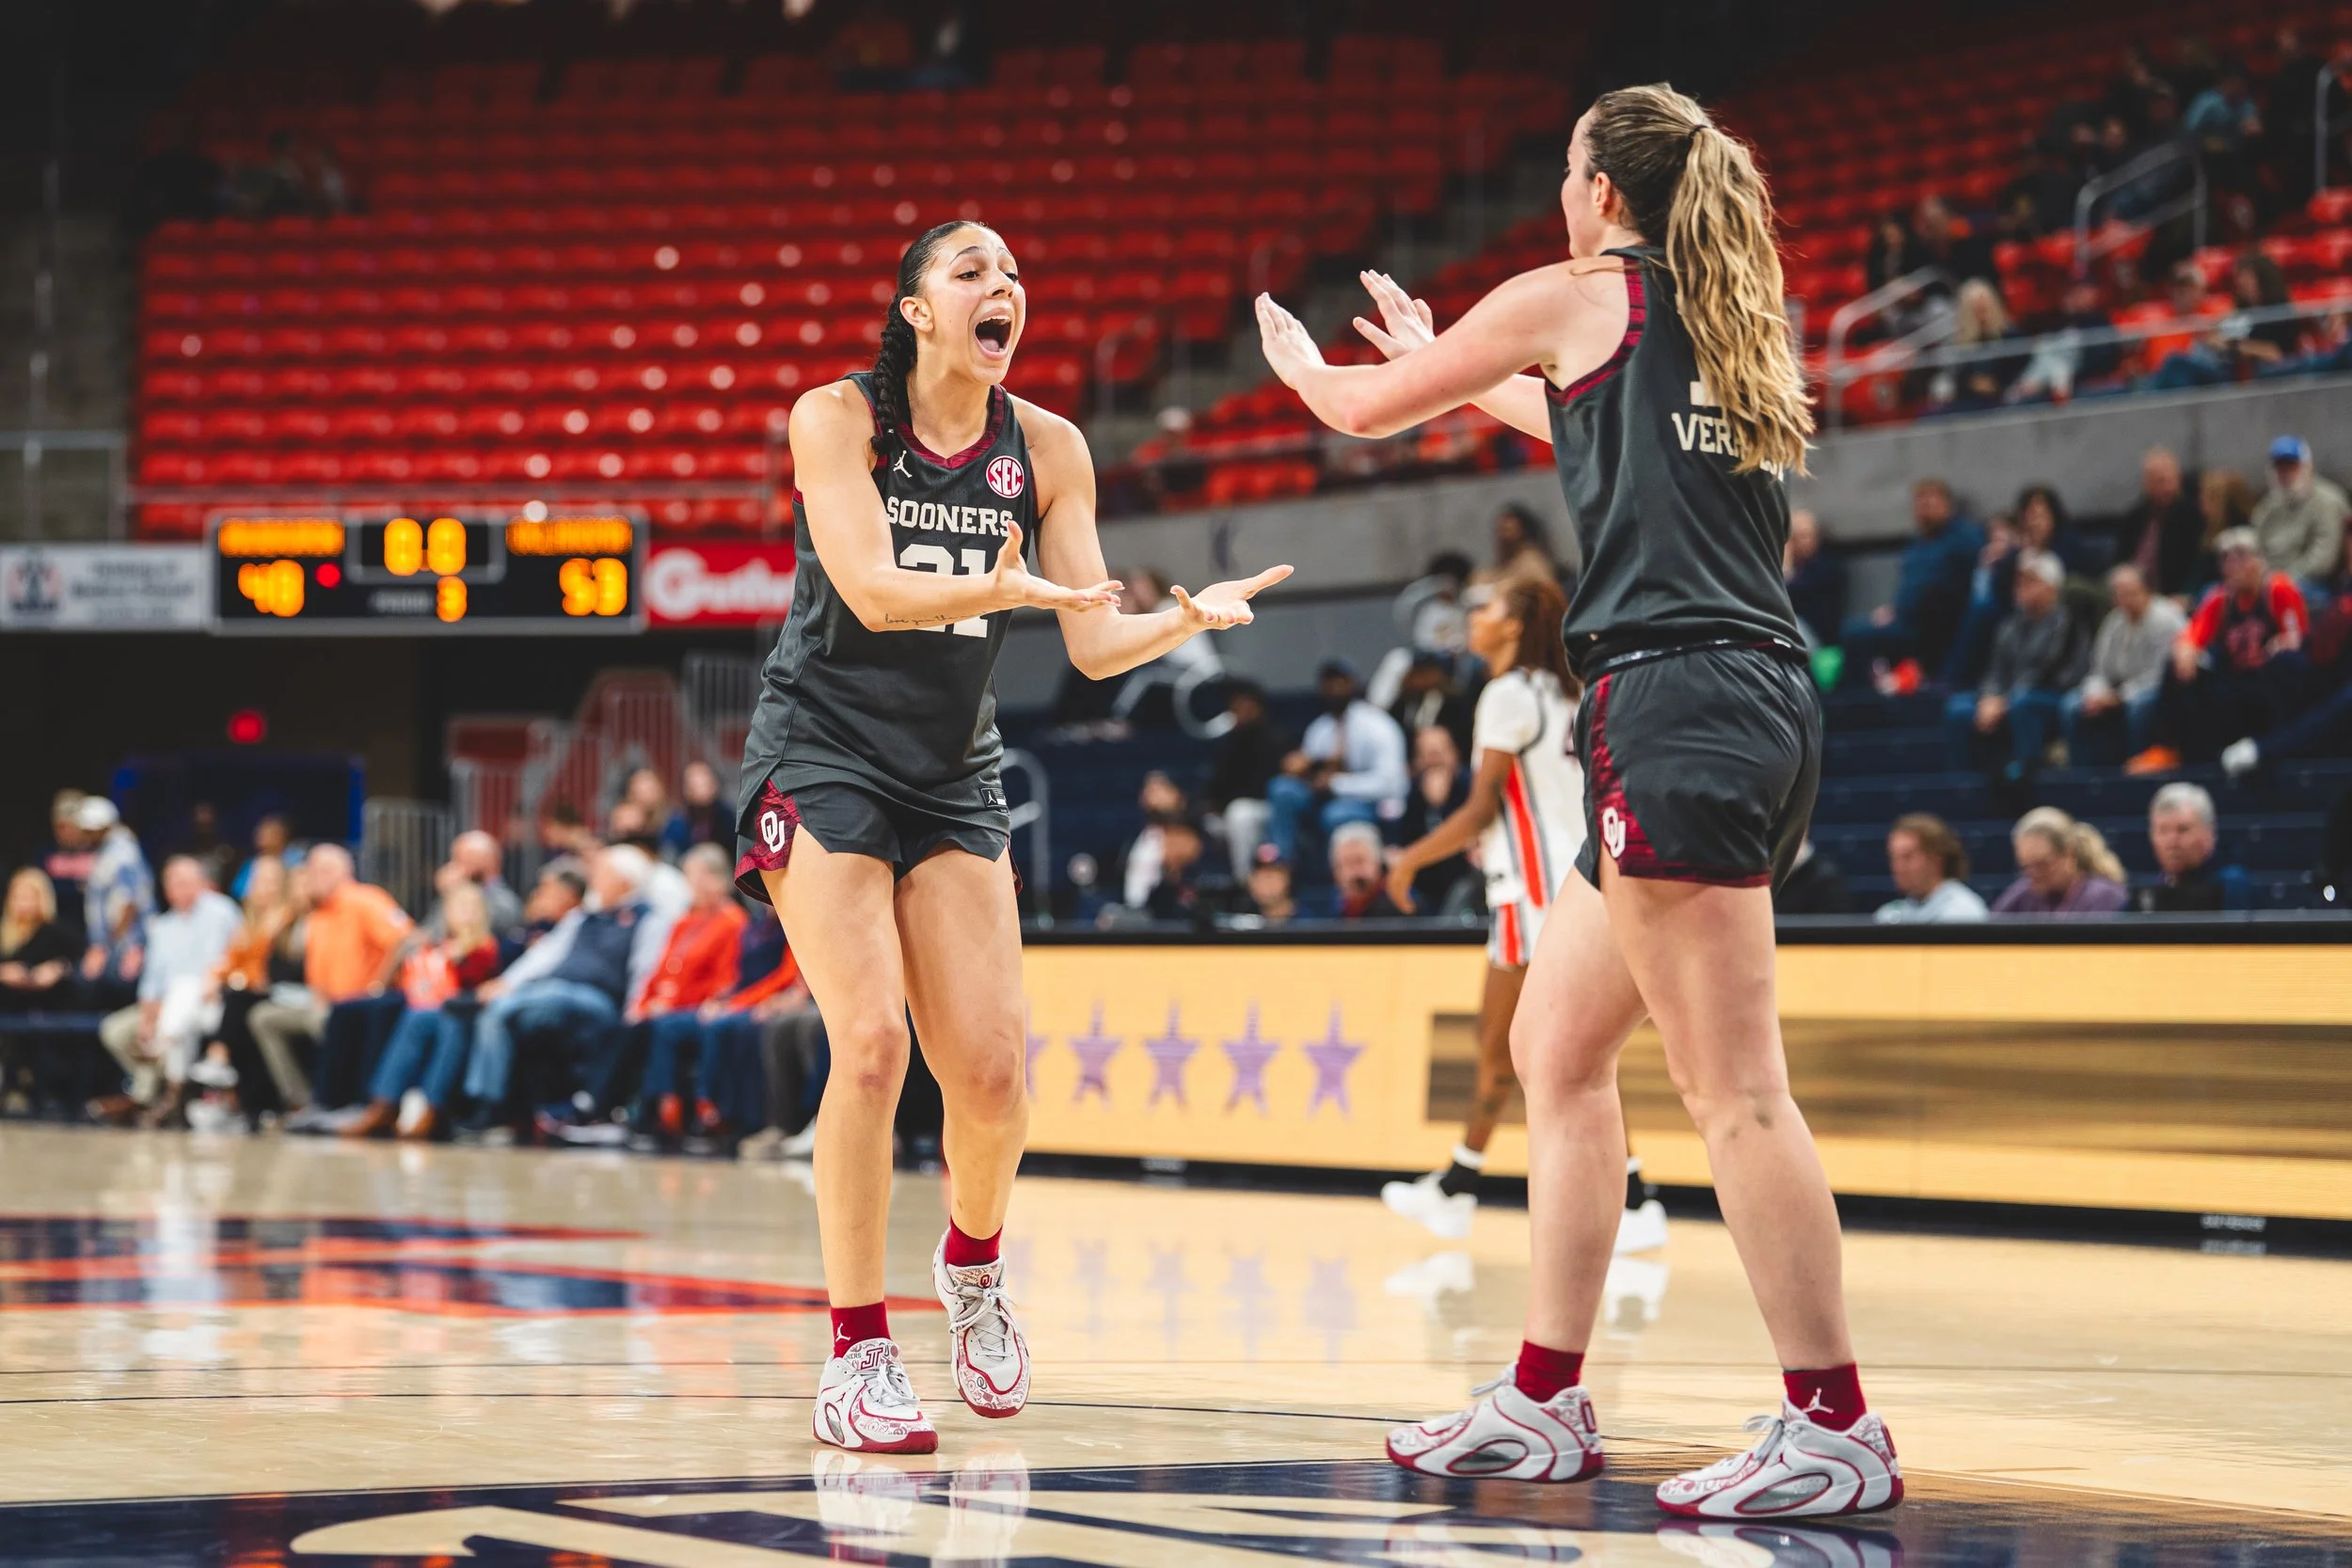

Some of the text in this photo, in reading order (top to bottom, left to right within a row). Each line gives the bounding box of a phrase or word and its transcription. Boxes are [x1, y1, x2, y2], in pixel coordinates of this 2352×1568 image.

[990, 458, 1022, 496] SEC
[886, 496, 1013, 537] SOONERS
[760, 811, 786, 853] OU
[1602, 806, 1627, 859] OU
